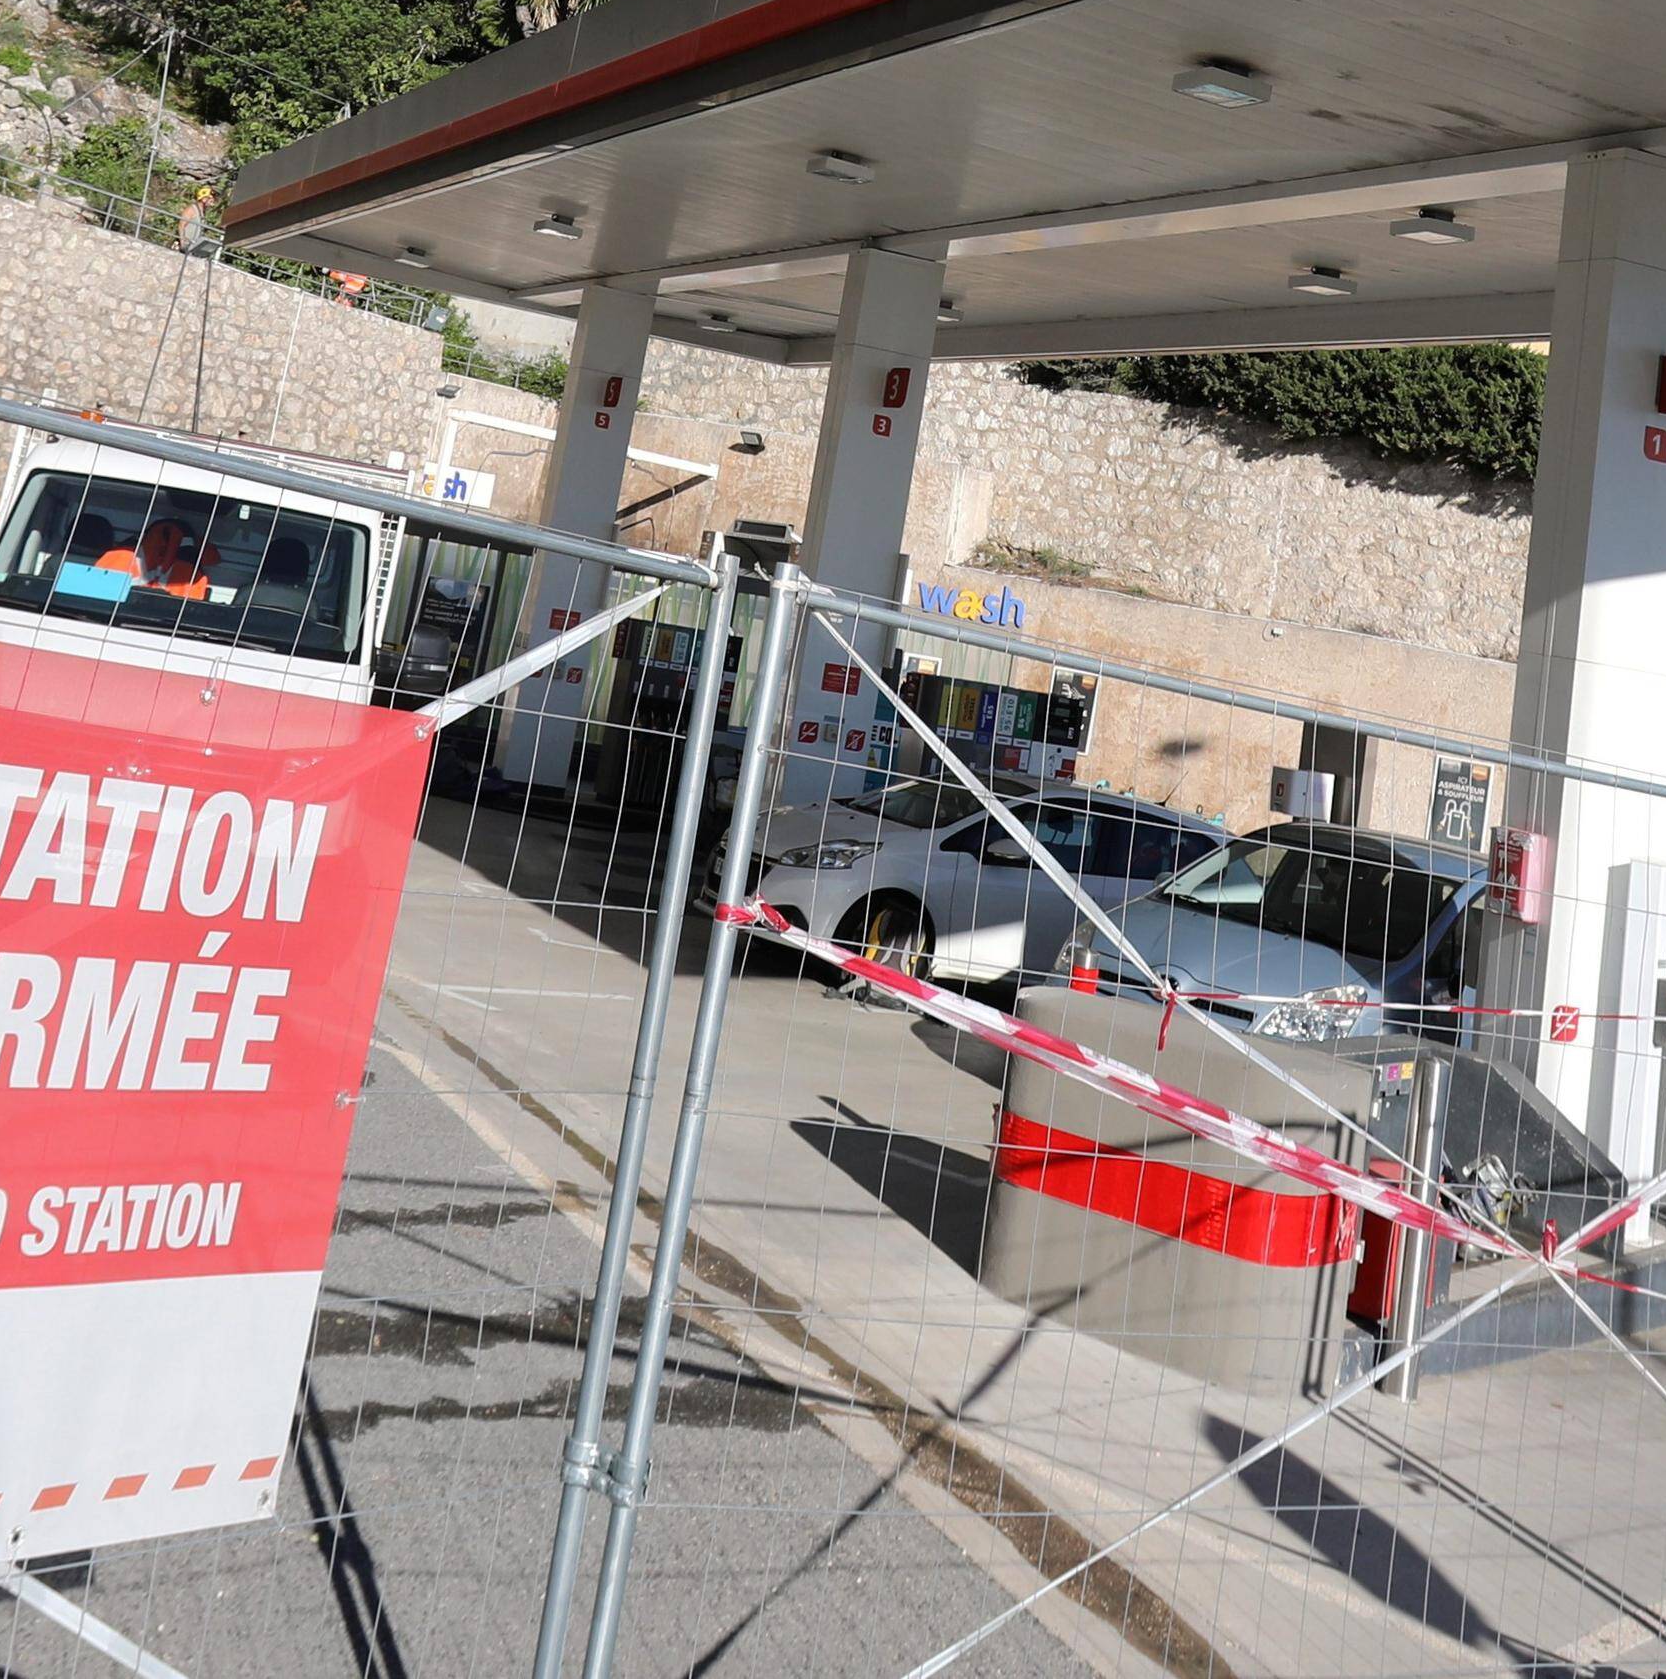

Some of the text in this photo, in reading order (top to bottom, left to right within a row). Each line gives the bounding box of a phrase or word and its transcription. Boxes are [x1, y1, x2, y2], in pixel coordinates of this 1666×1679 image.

[889, 374, 900, 401] 3
[597, 414, 607, 427] 5
[877, 418, 887, 433] 3
[1652, 433, 1661, 456] 1
[918, 582, 1026, 628] wash
[1438, 781, 1485, 796] ASPIRATEUR
[20, 1181, 243, 1258] STATION
